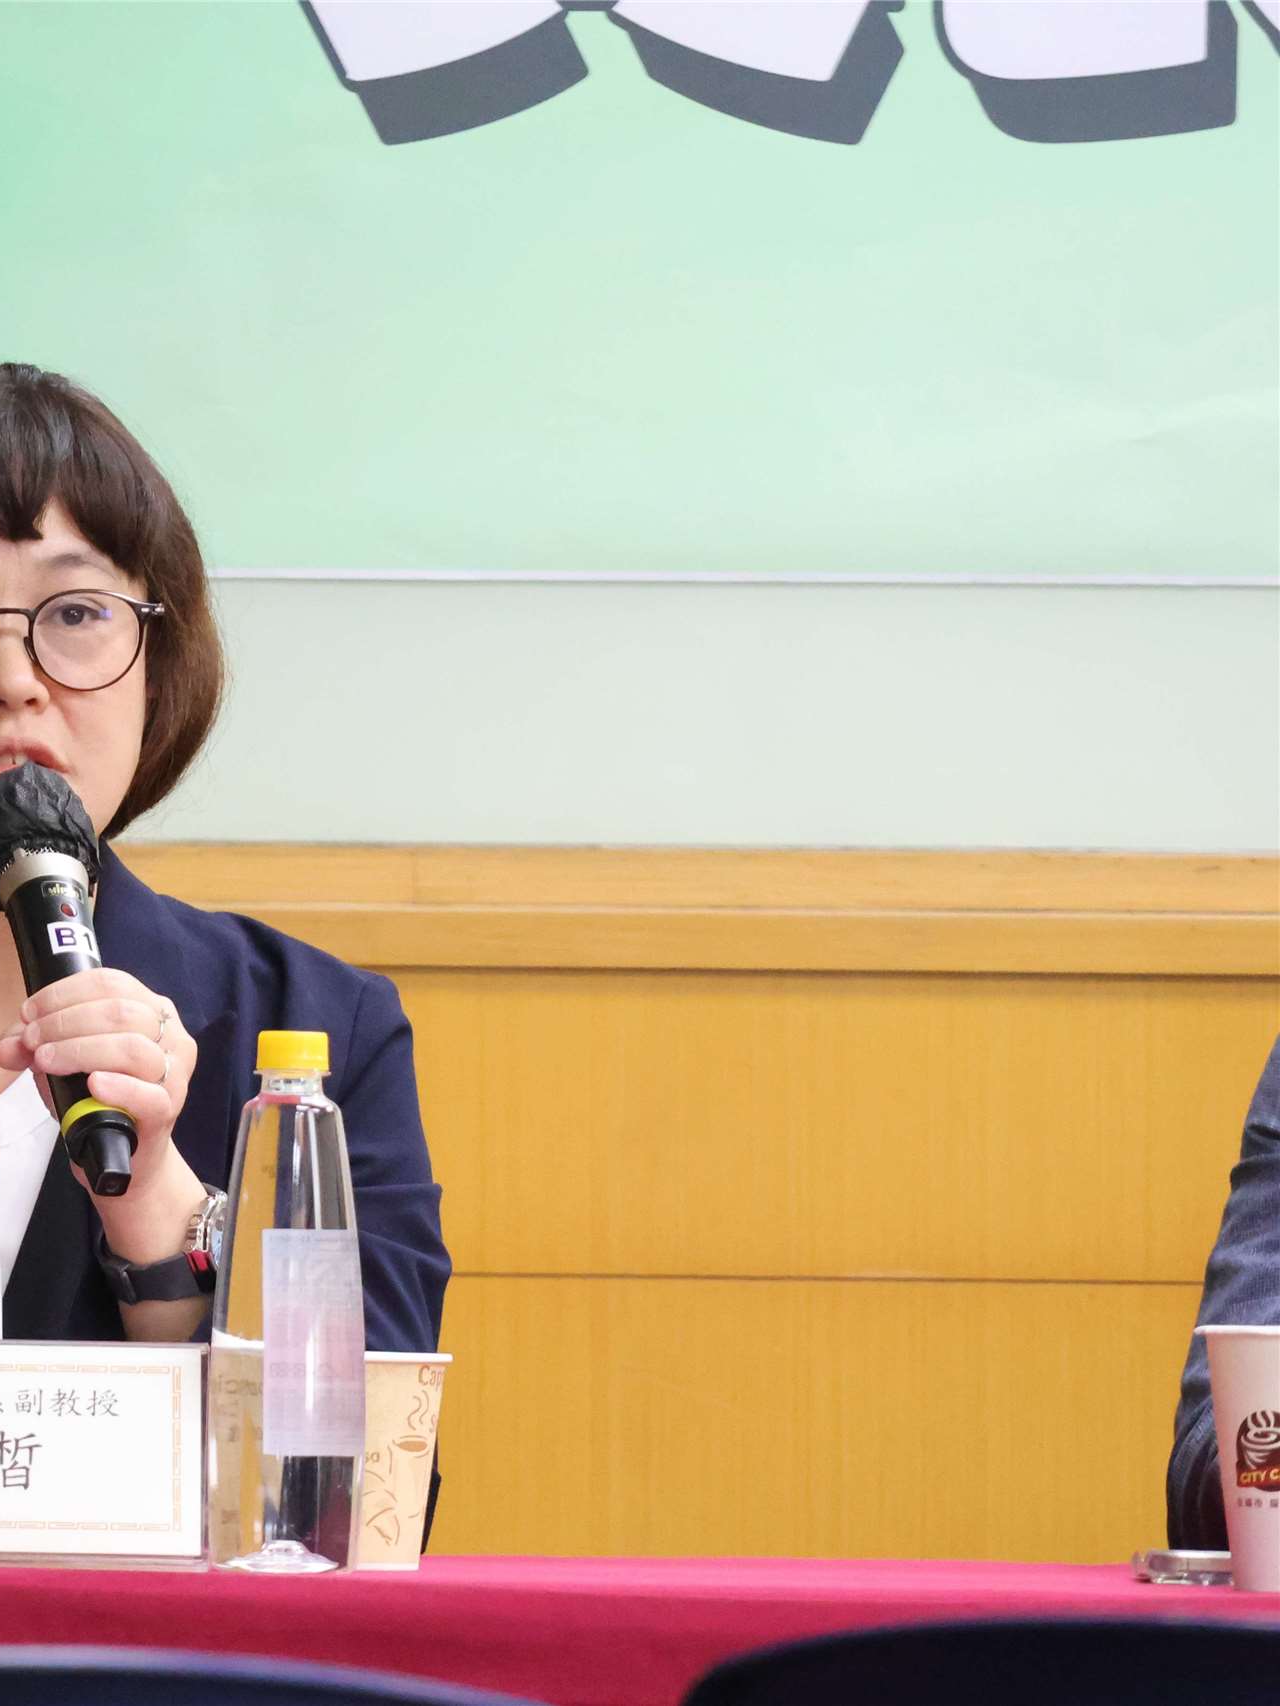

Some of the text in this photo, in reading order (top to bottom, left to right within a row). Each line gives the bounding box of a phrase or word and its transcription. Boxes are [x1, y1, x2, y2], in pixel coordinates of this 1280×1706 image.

[55, 927, 93, 952] B1
[1239, 1467, 1280, 1485] CITY C
